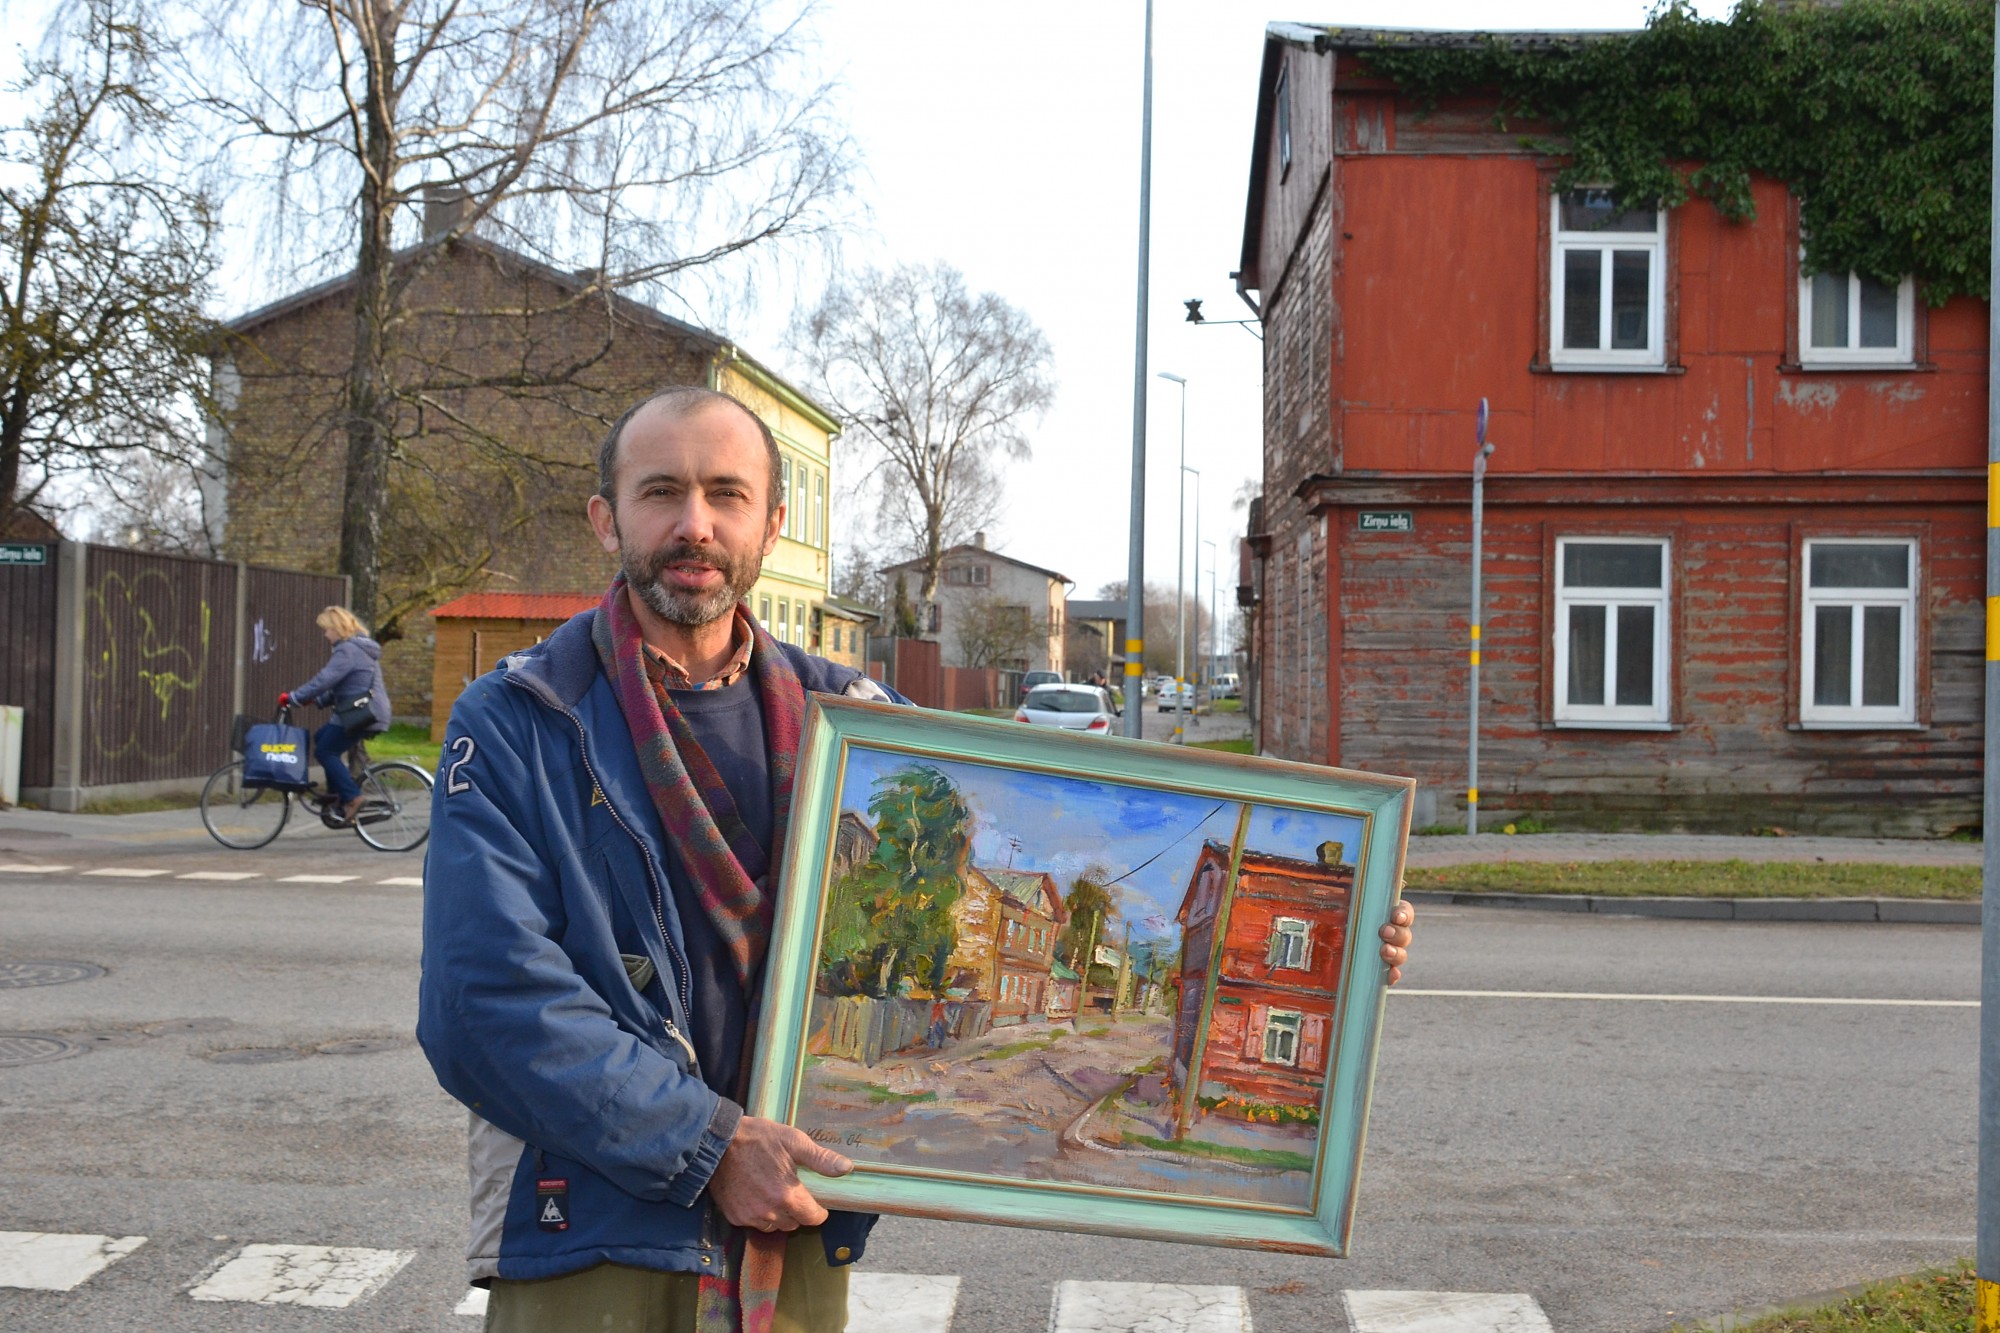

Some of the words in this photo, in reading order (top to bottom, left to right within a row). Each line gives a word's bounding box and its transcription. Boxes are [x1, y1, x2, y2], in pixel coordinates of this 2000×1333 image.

[1390, 514, 1408, 527] iela
[23, 547, 42, 560] iela
[260, 743, 297, 753] super
[266, 752, 298, 764] netto
